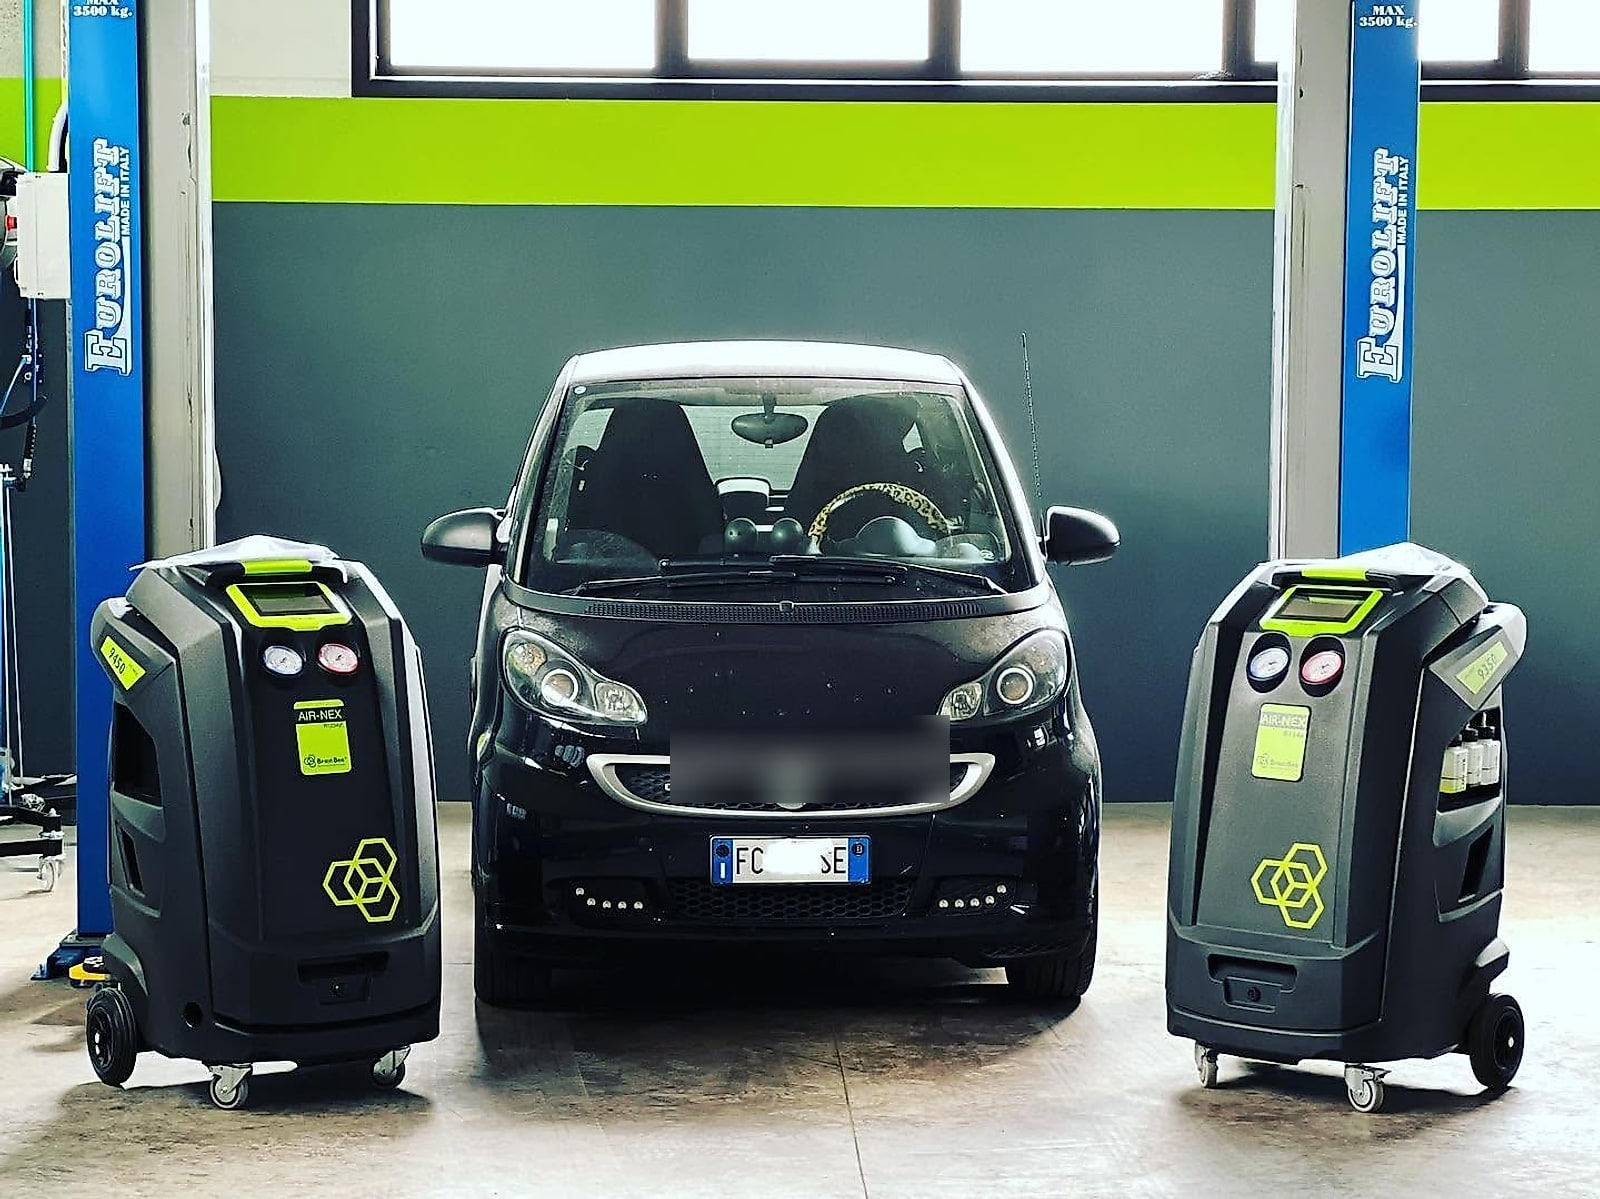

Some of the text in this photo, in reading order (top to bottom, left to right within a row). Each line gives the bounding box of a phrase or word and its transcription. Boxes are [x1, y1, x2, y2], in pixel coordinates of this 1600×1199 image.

[73, 6, 133, 18] 3500 kg.
[1373, 5, 1405, 15] MAX
[1359, 16, 1393, 27] 3500
[119, 147, 131, 237] MADE IN ITALY
[1397, 156, 1410, 245] MADE IN ITALY
[109, 647, 126, 675] 9450
[297, 708, 343, 722] AIR-NEX
[1261, 713, 1306, 727] AIR-NEX
[735, 846, 764, 875] FC
